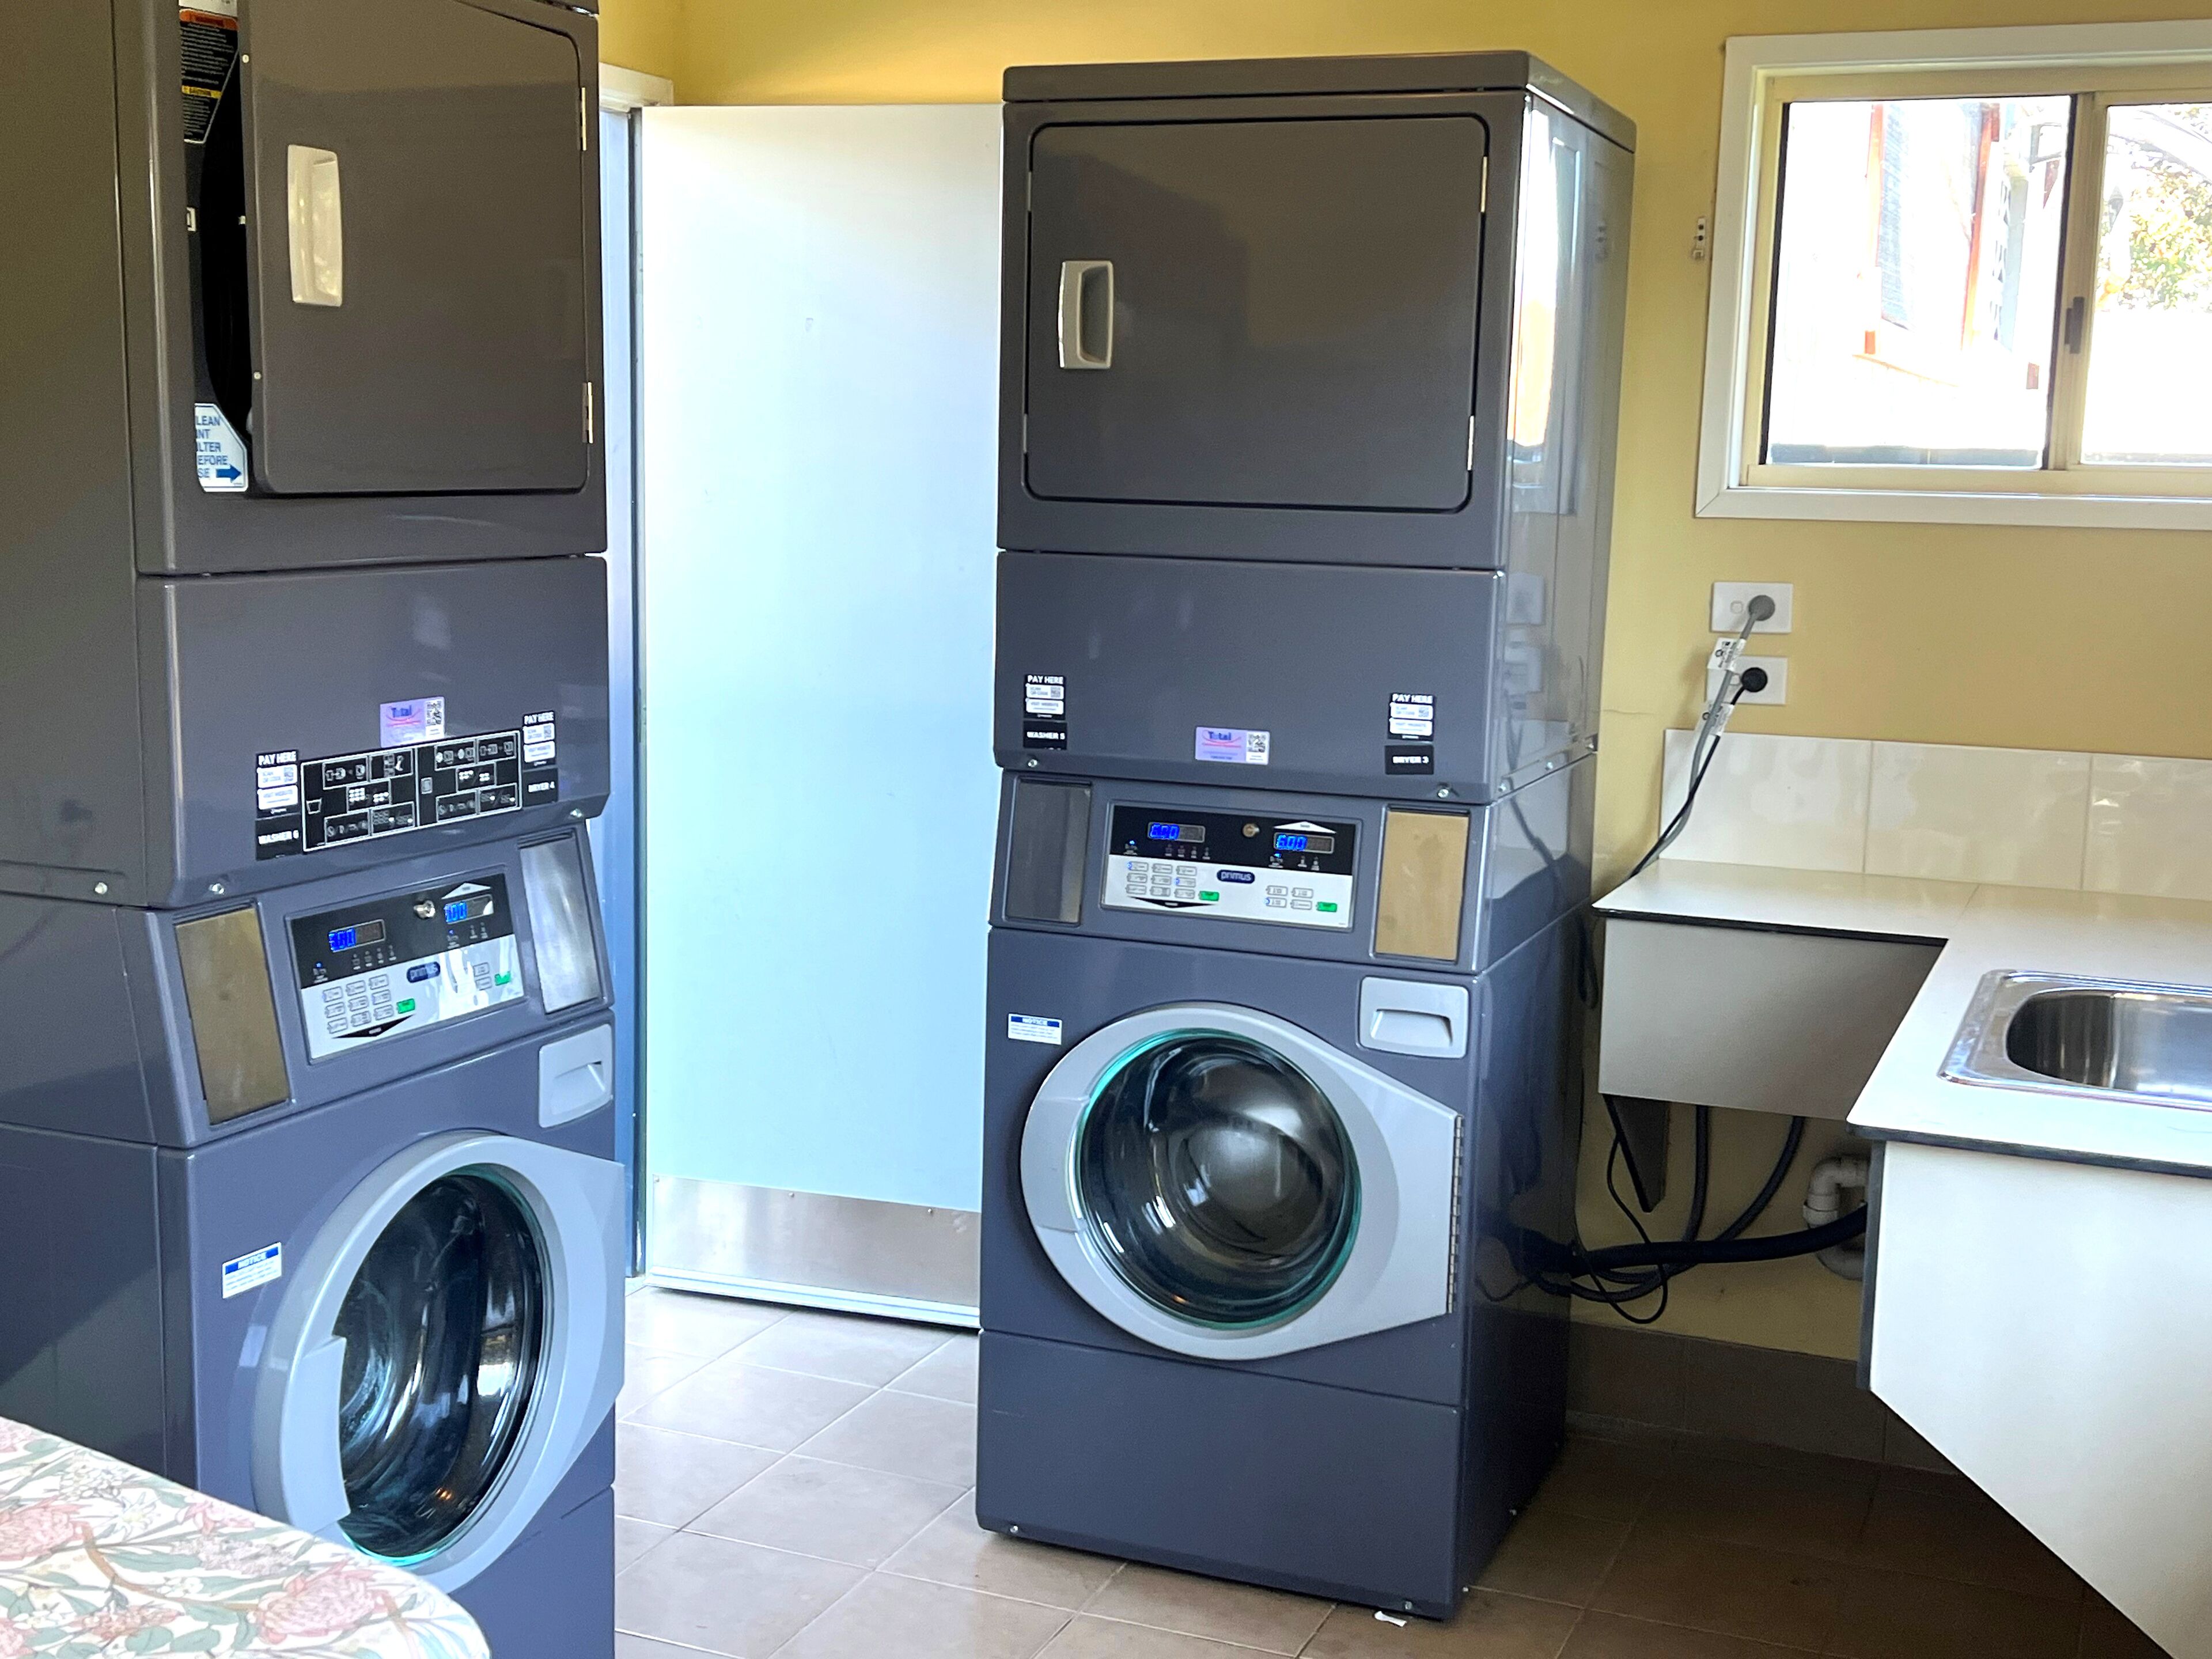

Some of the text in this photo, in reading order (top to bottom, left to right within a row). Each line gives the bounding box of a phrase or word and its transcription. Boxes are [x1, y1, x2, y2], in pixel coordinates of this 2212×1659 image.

[195, 416, 220, 425] LEAN
[197, 456, 228, 465] EFORE
[198, 468, 210, 478] SE
[1392, 694, 1433, 703] PAY HERE
[524, 712, 554, 724] PAY HERE
[1208, 731, 1232, 740] Total
[258, 751, 296, 766] PAY HERE
[258, 831, 292, 844] WASHER
[1221, 872, 1251, 881] primus
